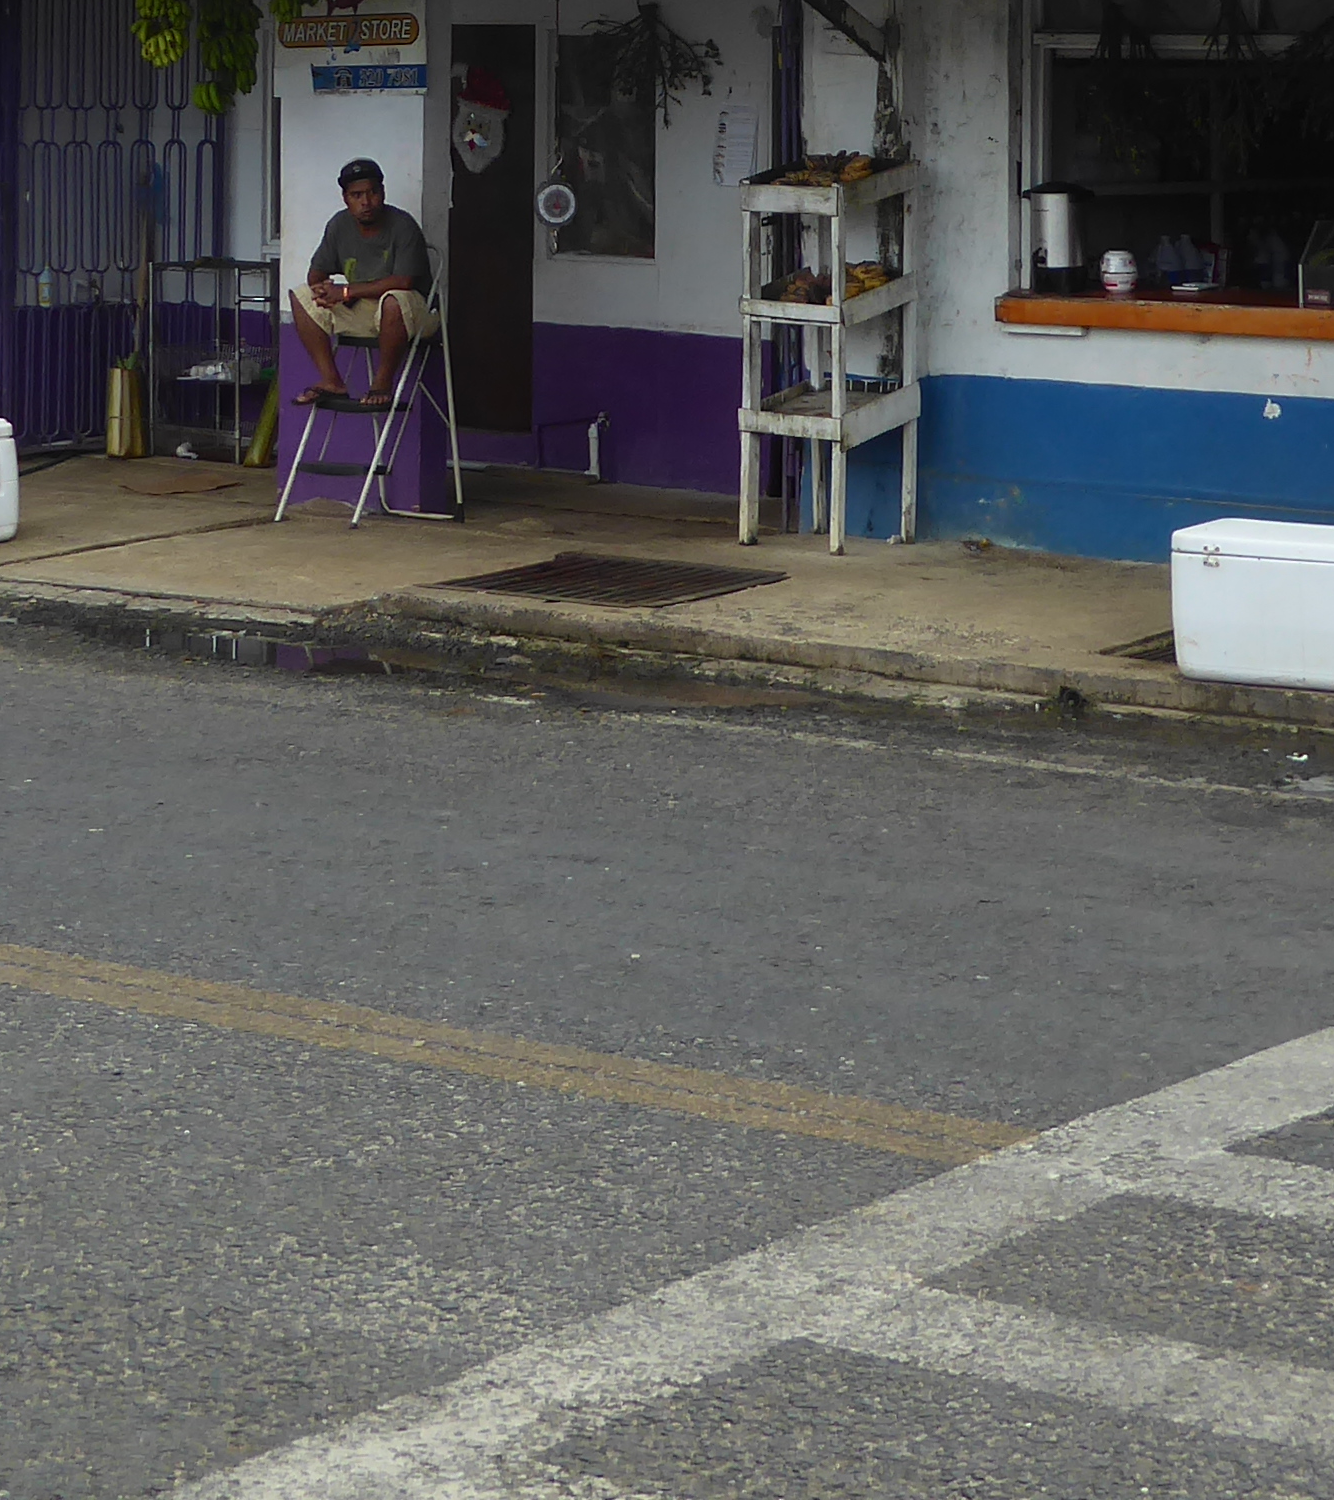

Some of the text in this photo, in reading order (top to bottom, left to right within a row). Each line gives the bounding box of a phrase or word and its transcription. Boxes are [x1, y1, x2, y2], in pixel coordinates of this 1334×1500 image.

[283, 19, 412, 42] MARKET STORE
[358, 68, 384, 87] 320
